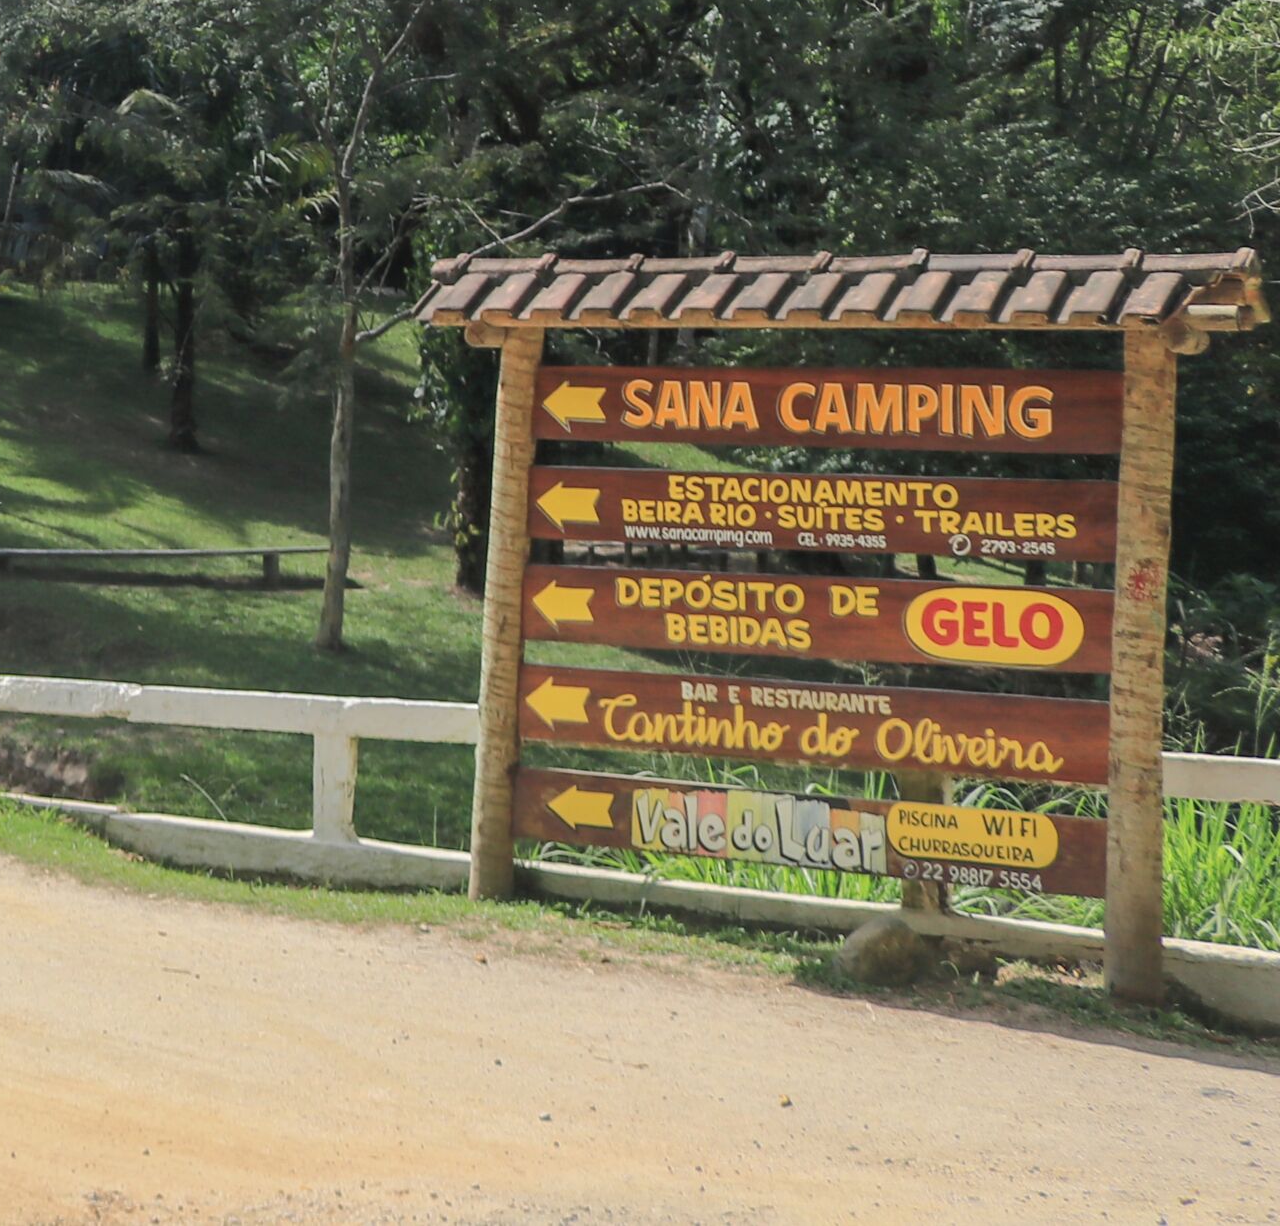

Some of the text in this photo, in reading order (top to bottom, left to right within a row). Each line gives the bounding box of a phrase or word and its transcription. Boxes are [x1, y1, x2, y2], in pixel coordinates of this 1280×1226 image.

[621, 378, 1055, 440] SANA CAMPING
[668, 474, 959, 509] ESTACIONAMENTO
[622, 498, 704, 523] BEIRA
[708, 506, 757, 526] RIO
[913, 510, 1078, 538] TRAILERS
[616, 575, 880, 617] DEPÓSITO DE
[665, 612, 813, 651] BEBIDAS
[920, 598, 1065, 651] GELO
[680, 681, 892, 716] BAR E RESTAURANTE
[599, 693, 1064, 774] Cantinho do Oliveira
[635, 790, 884, 873] Vale do Luar
[898, 809, 959, 829] PISCINA
[898, 835, 1035, 862] CHURRASQUEIRA
[922, 862, 1043, 892] 22 98817 5554
